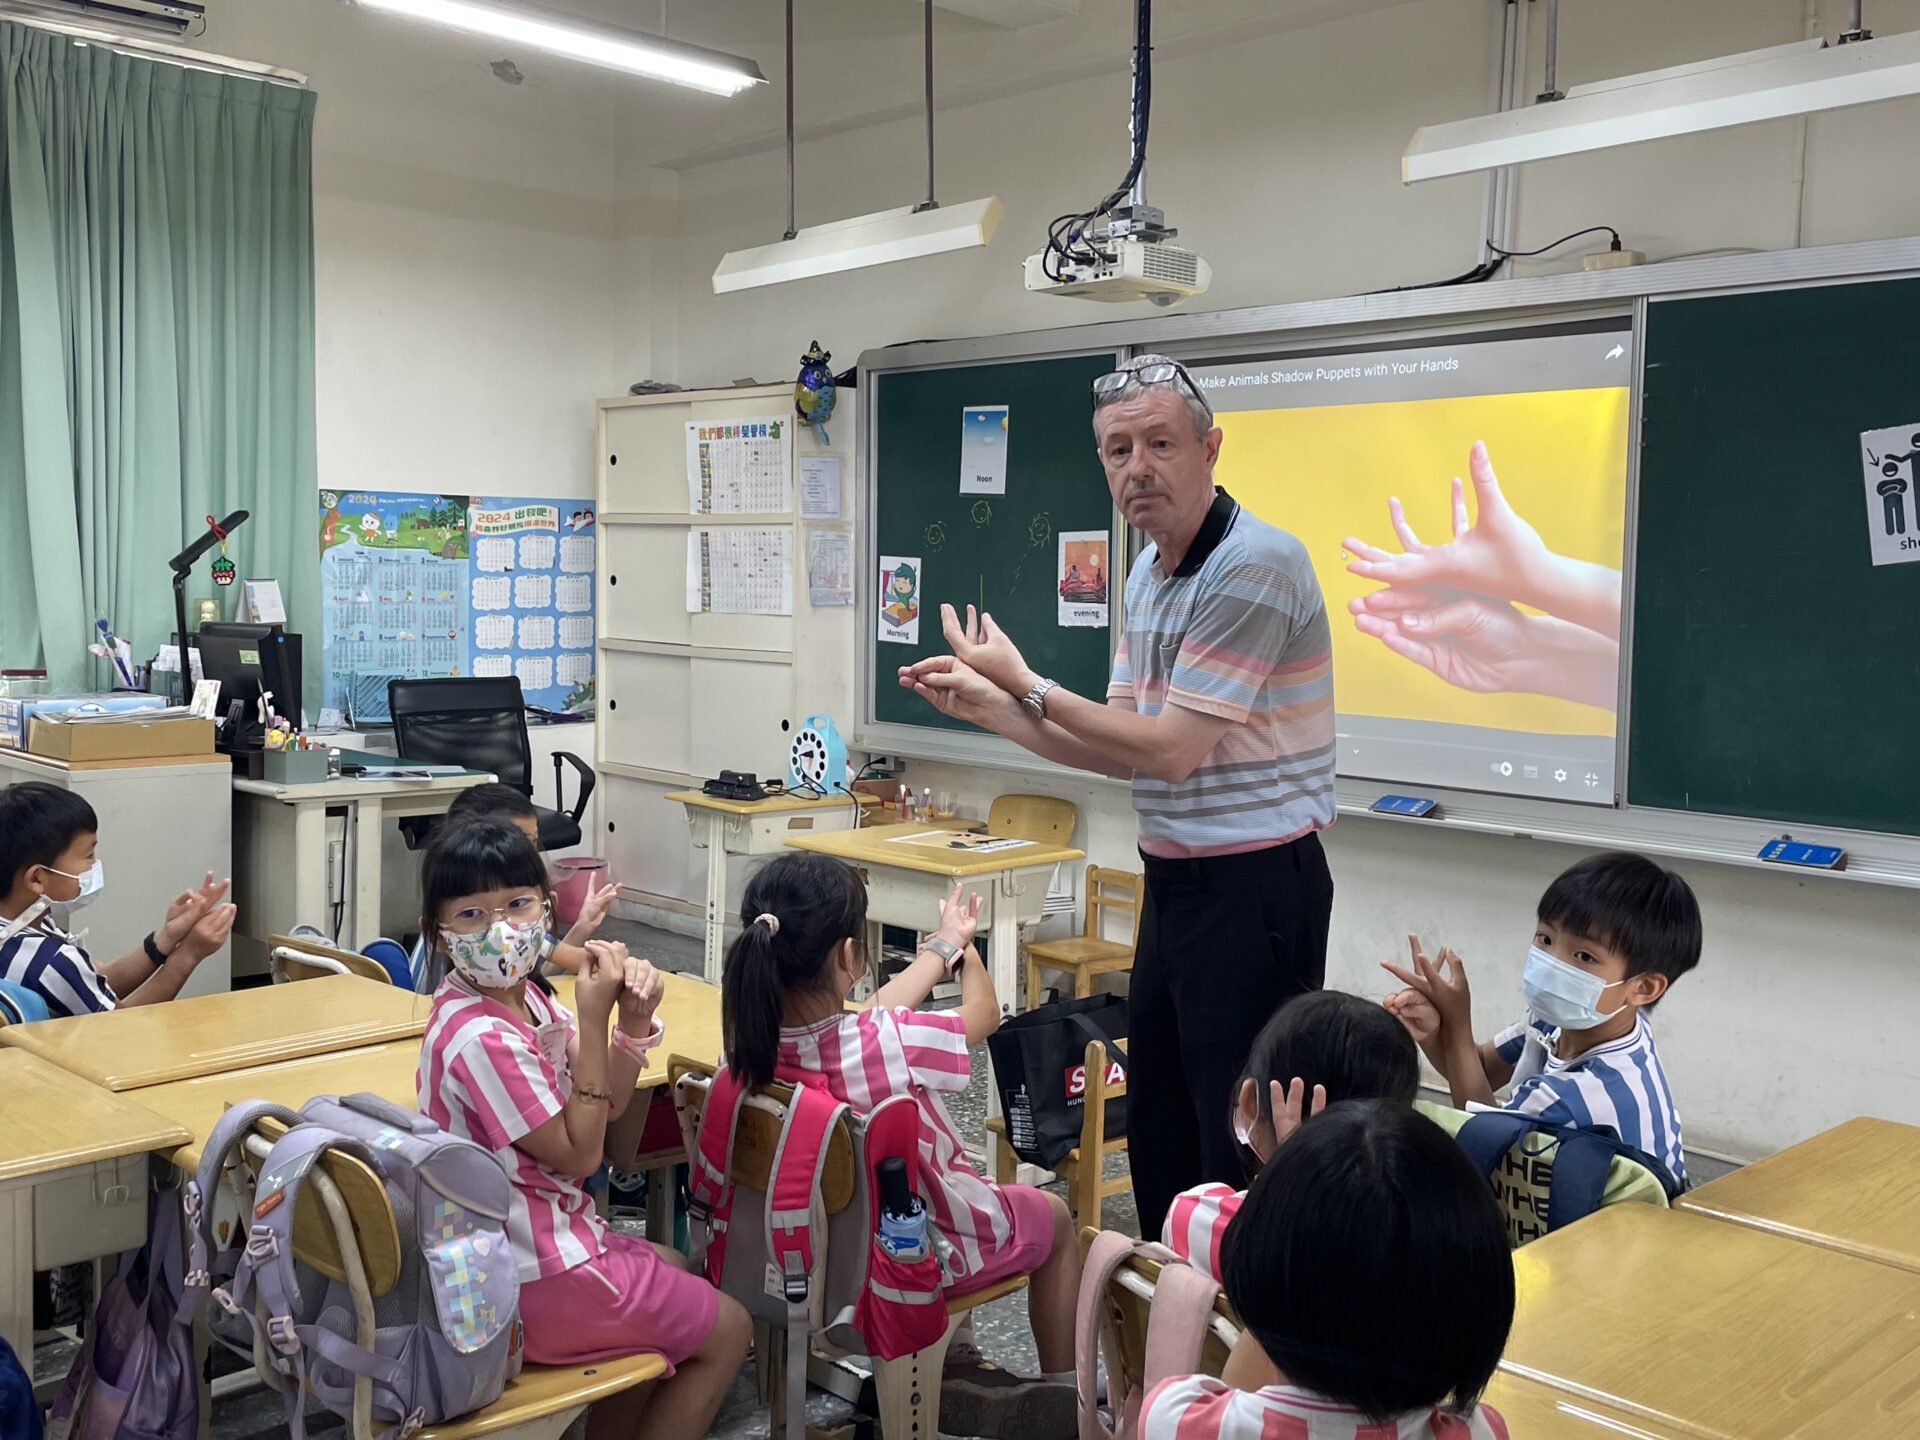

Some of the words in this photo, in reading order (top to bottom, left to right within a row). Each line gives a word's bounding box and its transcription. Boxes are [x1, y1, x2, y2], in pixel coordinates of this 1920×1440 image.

[1199, 375, 1226, 388] Make
[1228, 372, 1269, 387] Animals
[1271, 369, 1314, 384] Shadow
[1316, 367, 1361, 381] Puppets
[1364, 363, 1388, 377] with
[1391, 360, 1418, 375] Your
[1420, 357, 1459, 372] Hands
[698, 424, 767, 441] 我們都很棒榮譽榜
[976, 474, 993, 483] Noon
[477, 511, 511, 524] 2024
[1900, 536, 1920, 550] sh
[1073, 610, 1100, 620] evening
[886, 629, 910, 640] Morning
[1069, 1062, 1125, 1093] SA
